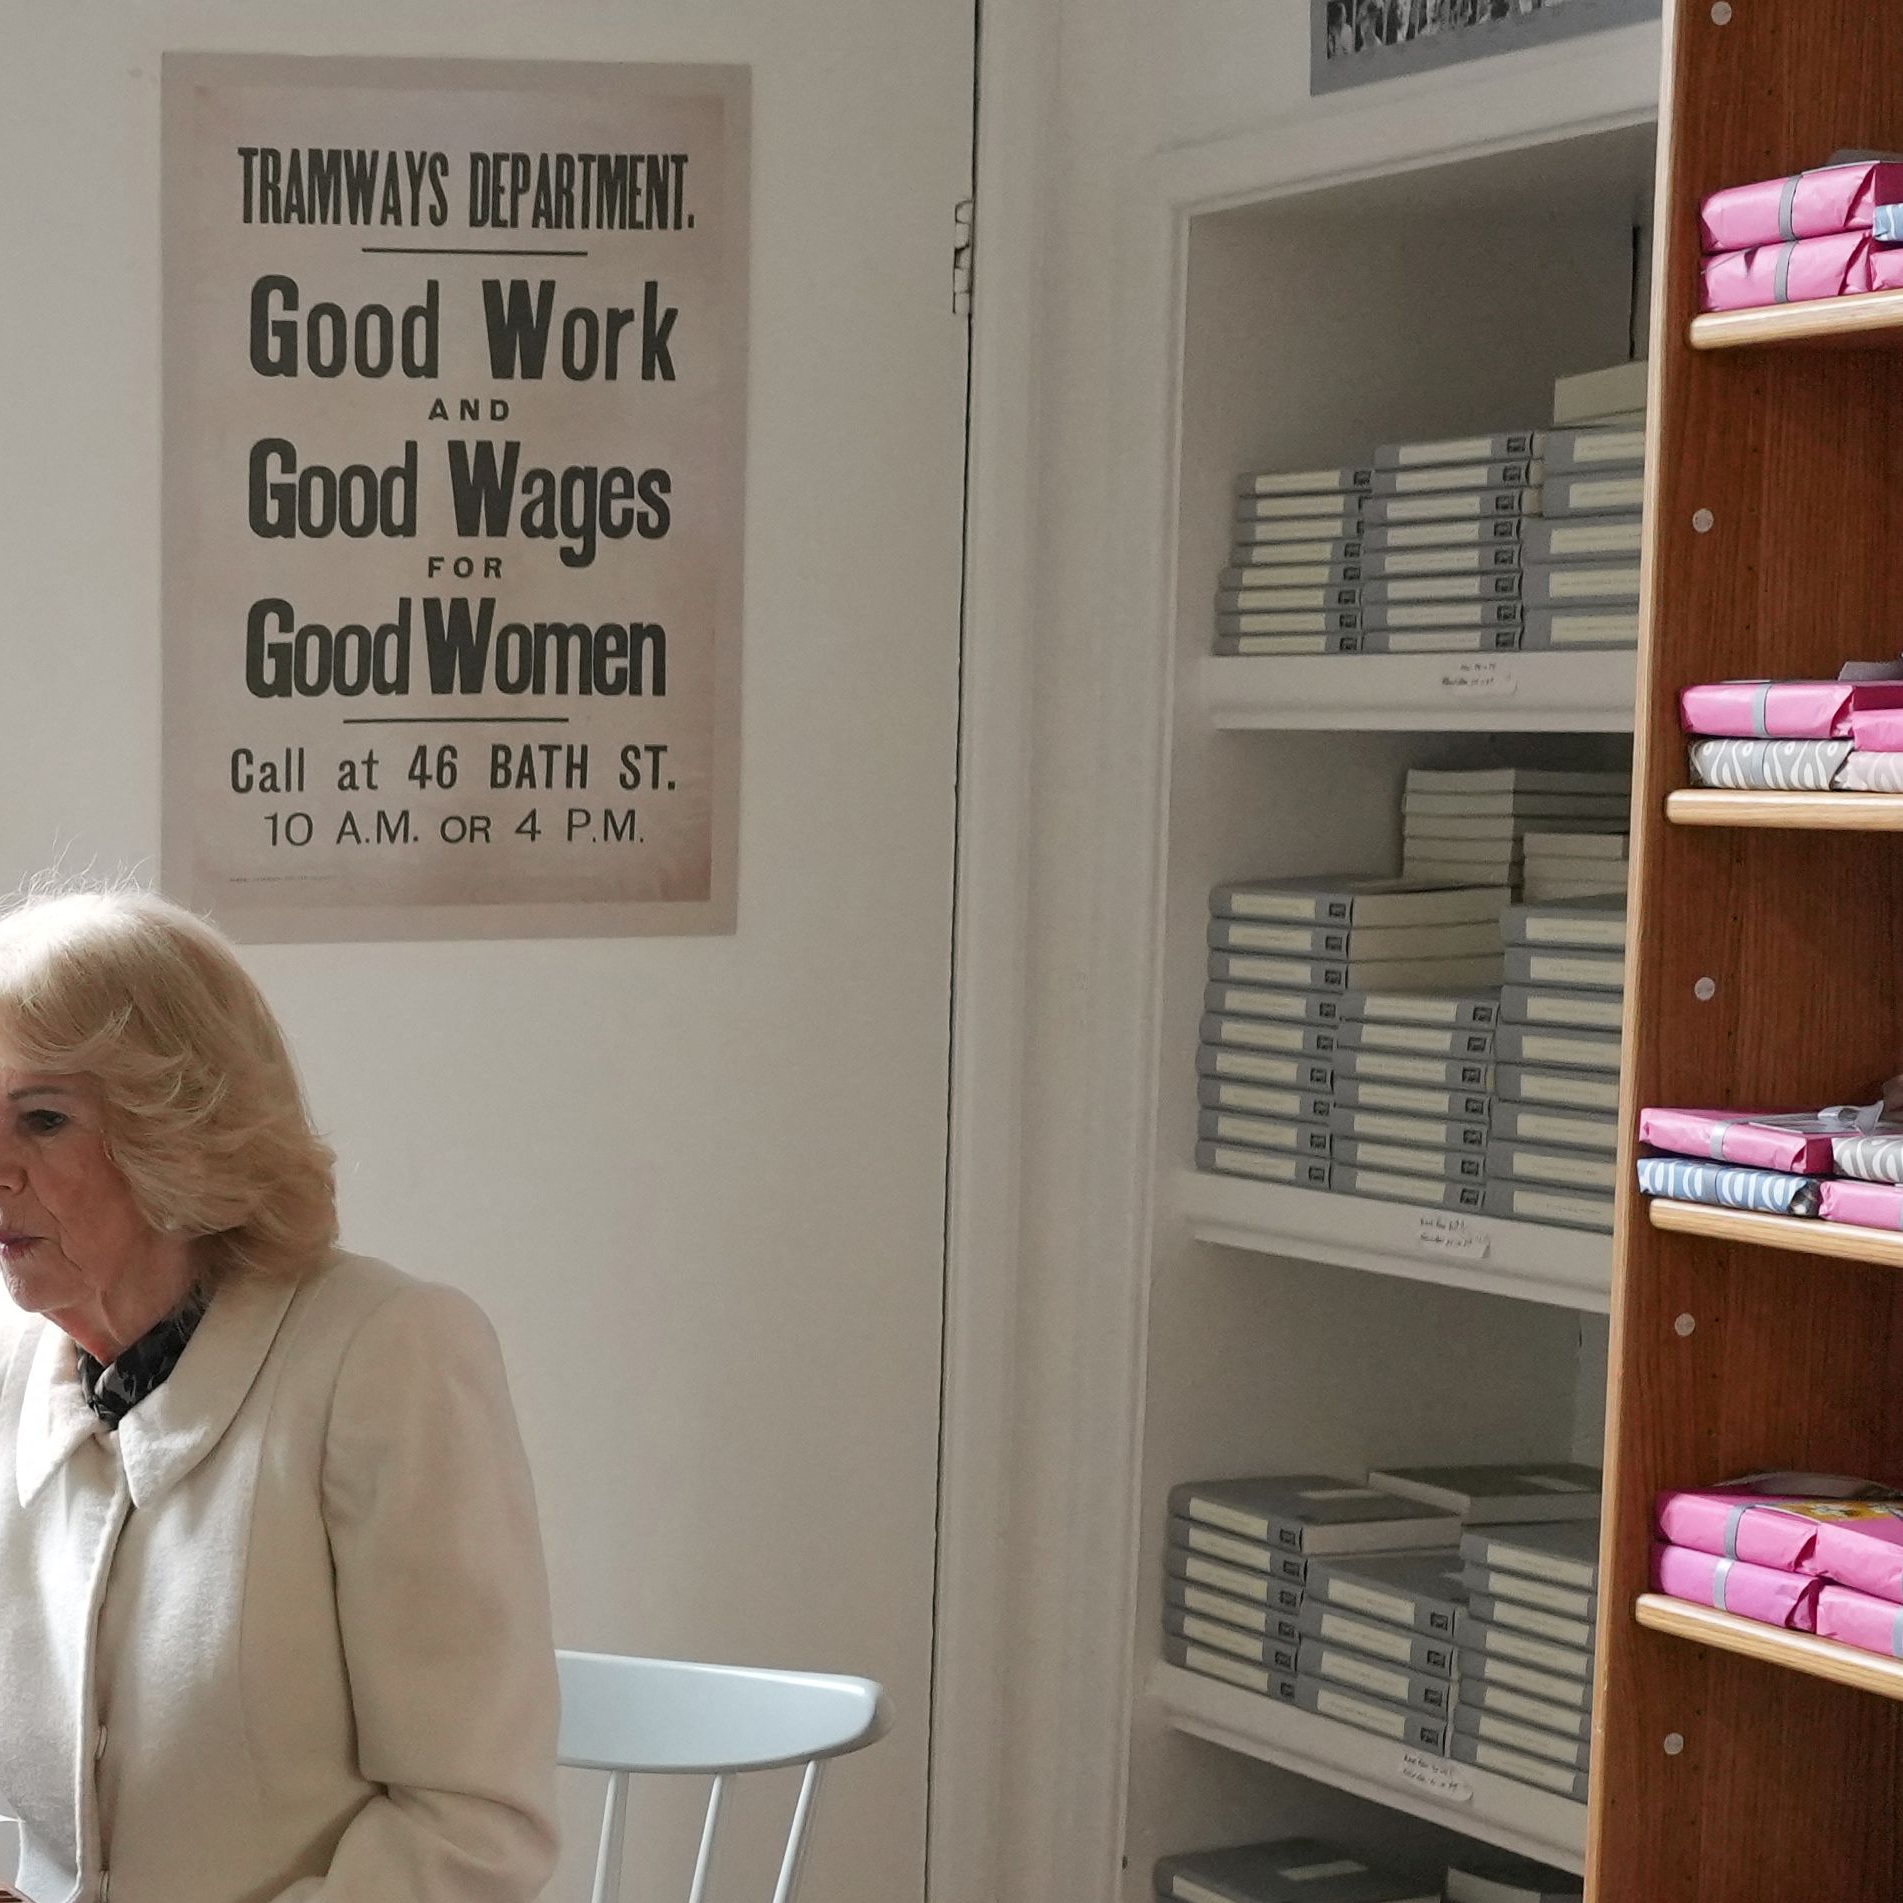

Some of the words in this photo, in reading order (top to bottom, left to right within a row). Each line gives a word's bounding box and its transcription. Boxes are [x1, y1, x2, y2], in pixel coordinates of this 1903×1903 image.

[237, 147, 449, 227] TRAMWAYS
[469, 152, 695, 232] DEPARTMENT.
[250, 275, 439, 379] Good
[482, 279, 678, 382] Work
[428, 398, 509, 421] AND
[249, 438, 418, 539] Good
[448, 440, 671, 568] Wages
[428, 556, 502, 579] FOR
[246, 597, 412, 698] Good
[423, 597, 666, 697] Women
[231, 747, 304, 794] Call
[338, 749, 379, 791] at
[408, 744, 457, 790] 46
[490, 743, 588, 790] BATH
[619, 744, 675, 791] ST.
[264, 813, 313, 846] 10
[336, 810, 418, 845] A.M.
[440, 815, 491, 844] OR
[514, 808, 541, 842] 4
[567, 808, 644, 843] P.M.
